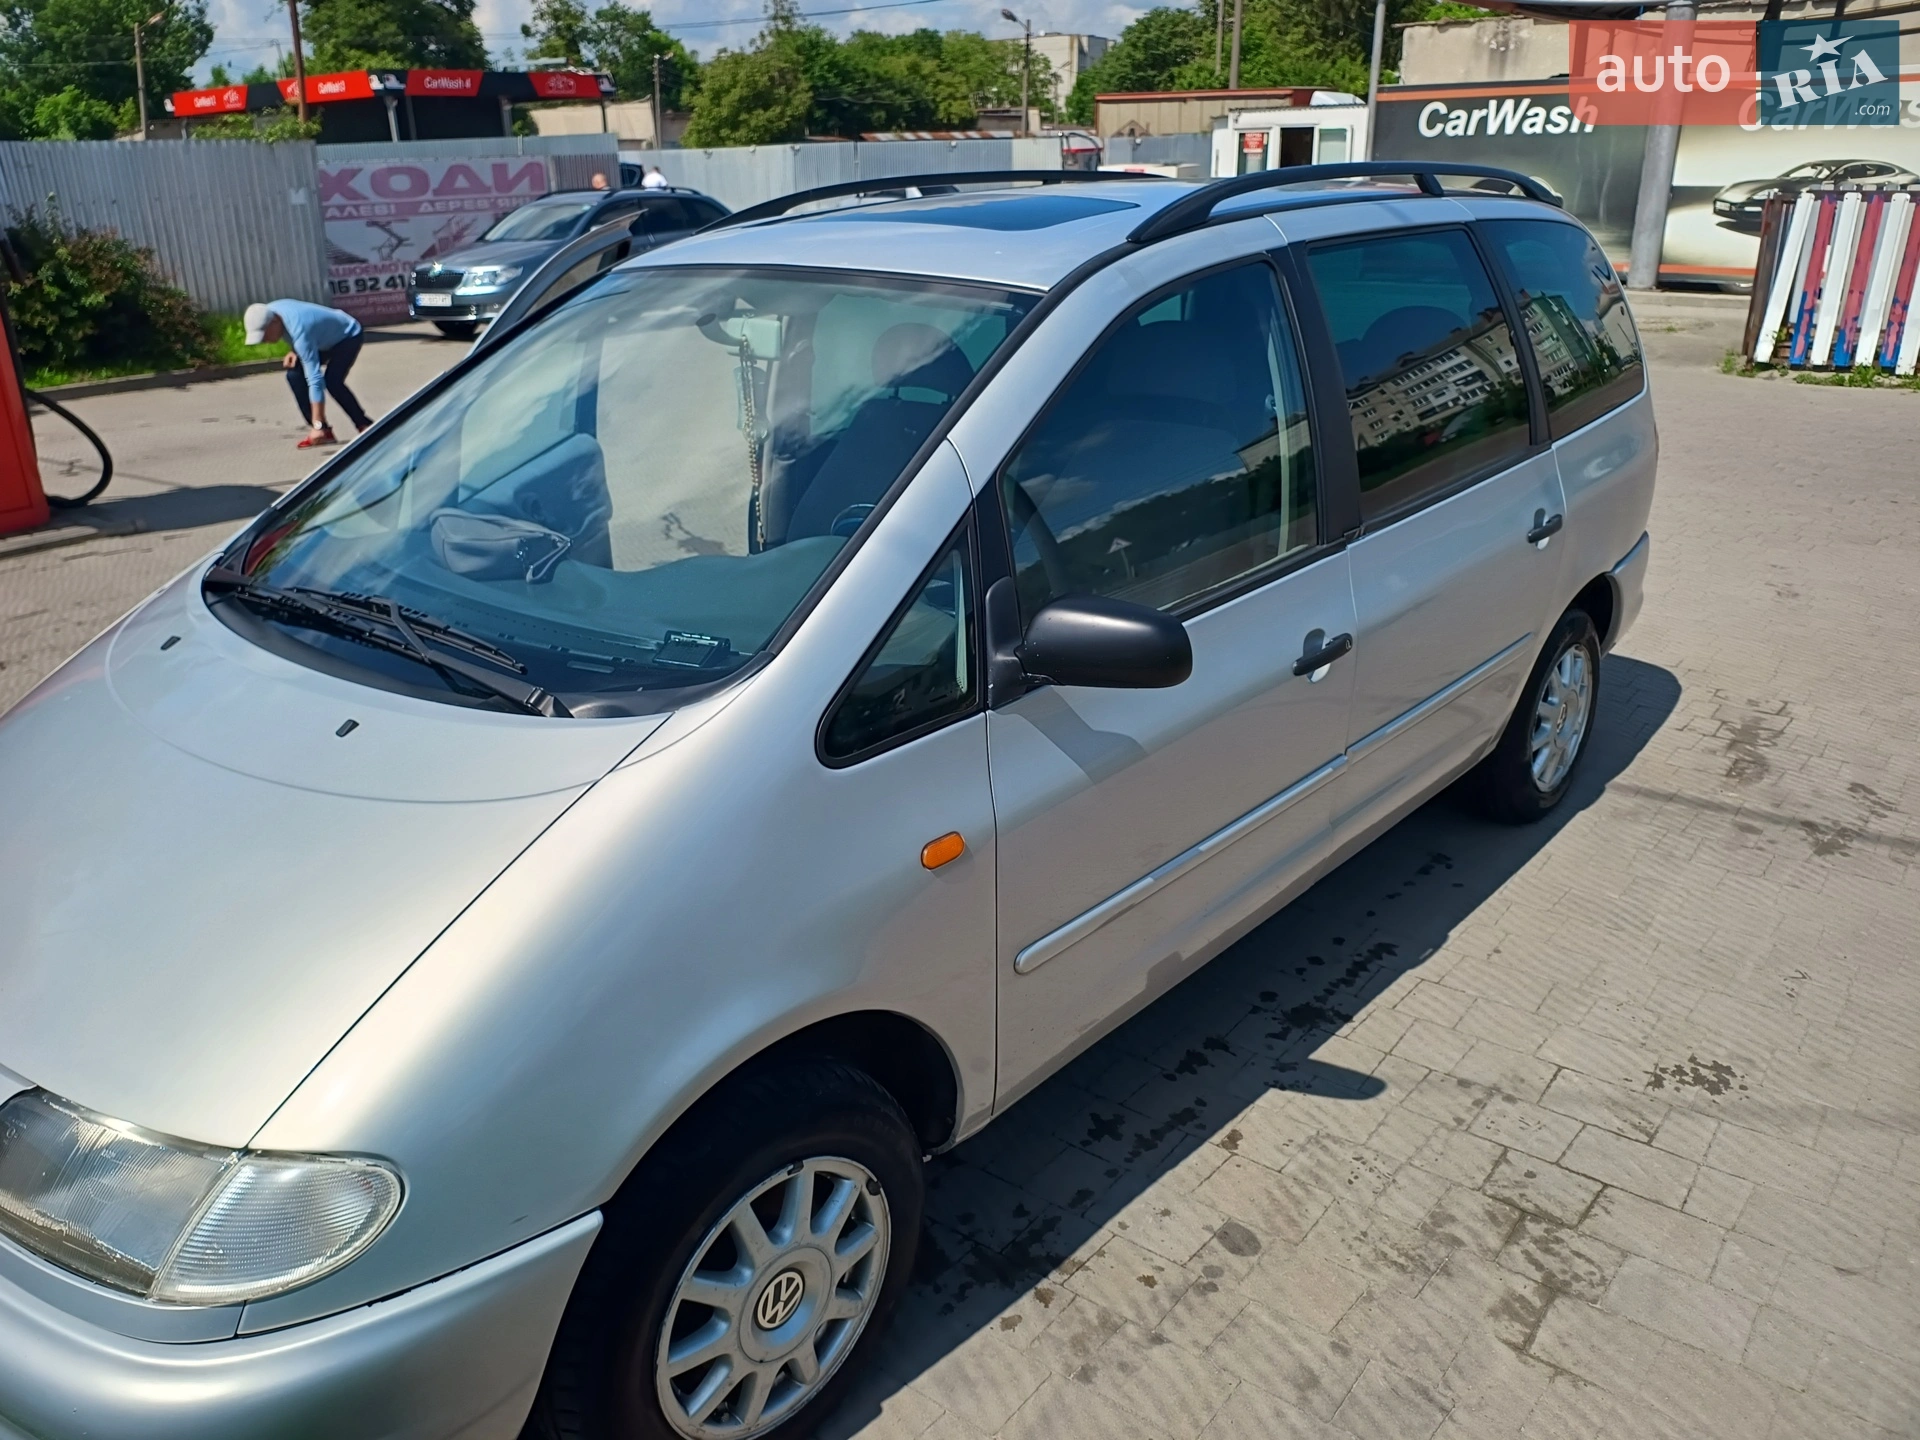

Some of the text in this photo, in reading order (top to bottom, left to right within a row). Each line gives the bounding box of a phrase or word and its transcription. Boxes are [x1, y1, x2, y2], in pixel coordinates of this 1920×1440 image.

[1418, 96, 1599, 138] CarWash
[355, 277, 381, 292] 92
[385, 273, 406, 289] 41
